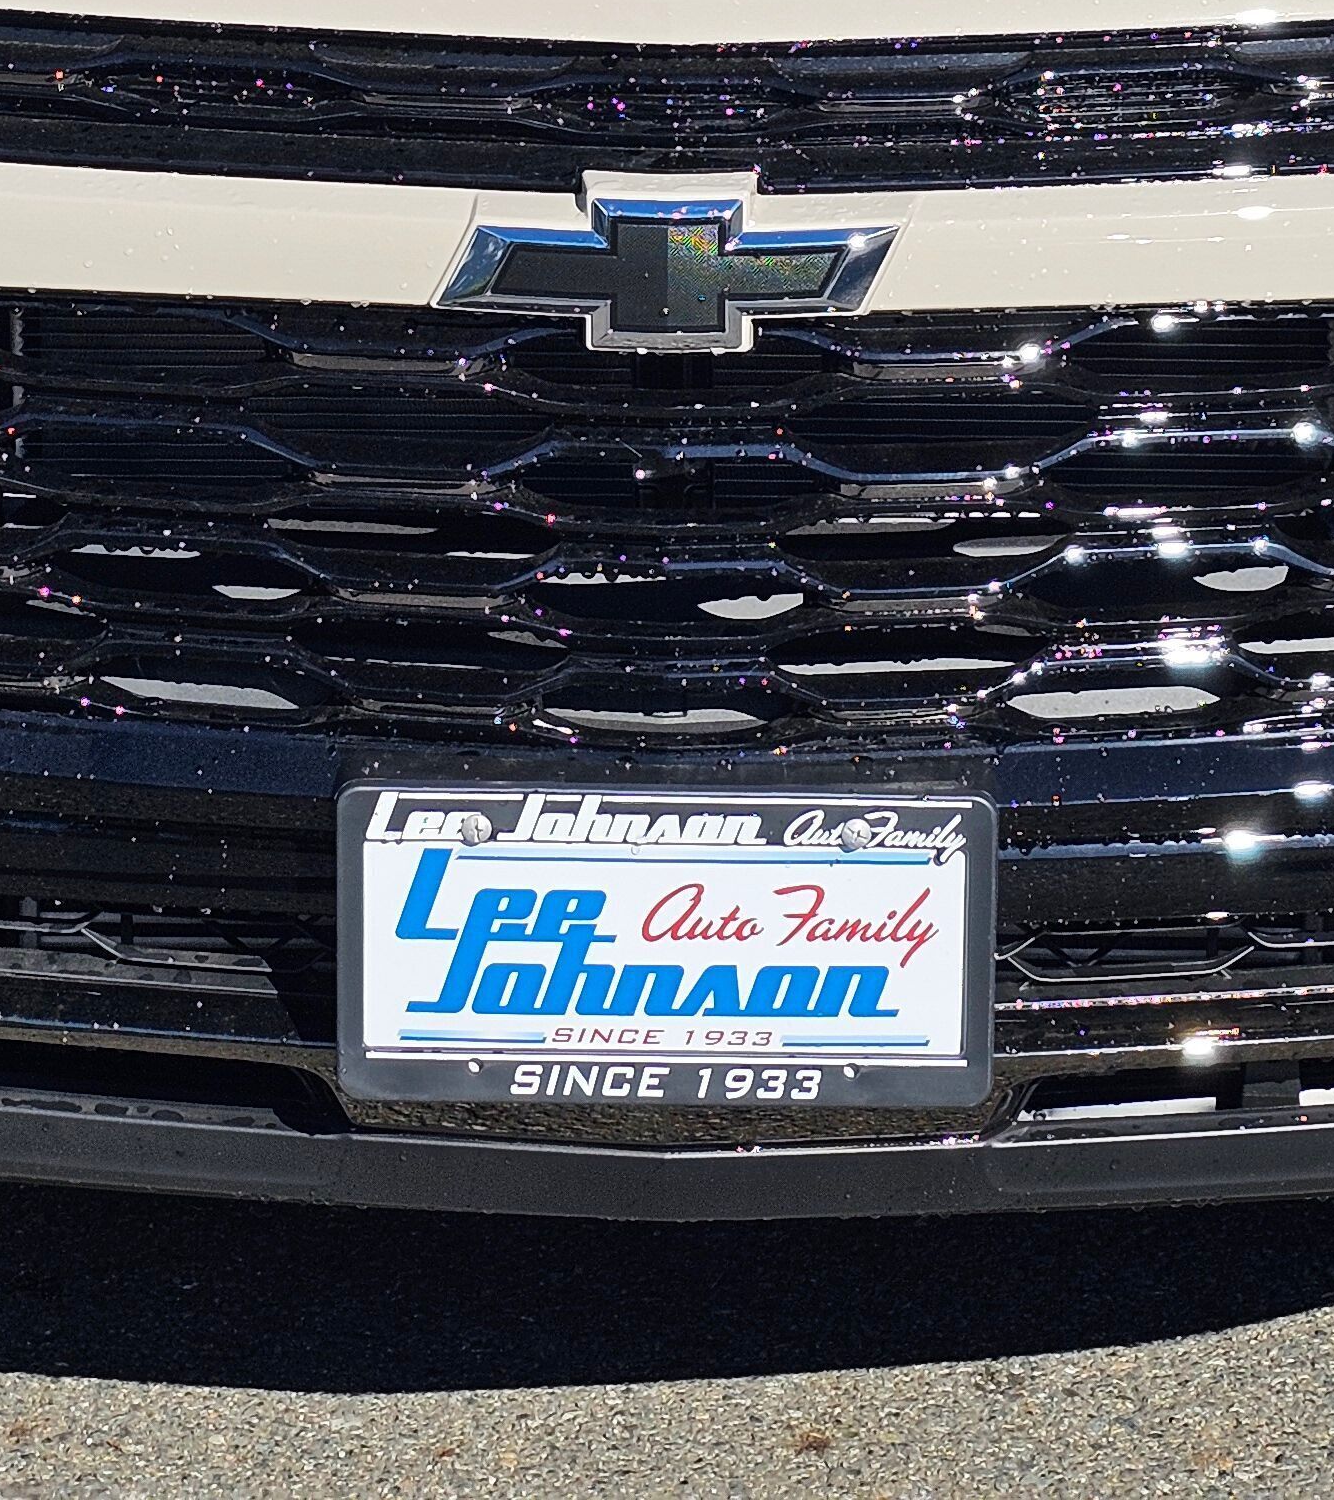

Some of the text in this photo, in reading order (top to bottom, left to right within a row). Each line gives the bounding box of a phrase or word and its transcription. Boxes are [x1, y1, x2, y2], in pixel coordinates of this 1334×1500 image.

[496, 793, 767, 845] Johnson
[783, 809, 857, 846] Aut
[864, 810, 967, 863] Family
[395, 848, 617, 943] Lee
[641, 883, 940, 968] Auto Family
[405, 924, 900, 1017] Johnson
[551, 1026, 773, 1046] SINCE 1933
[510, 1063, 822, 1100] SINCE 1933
